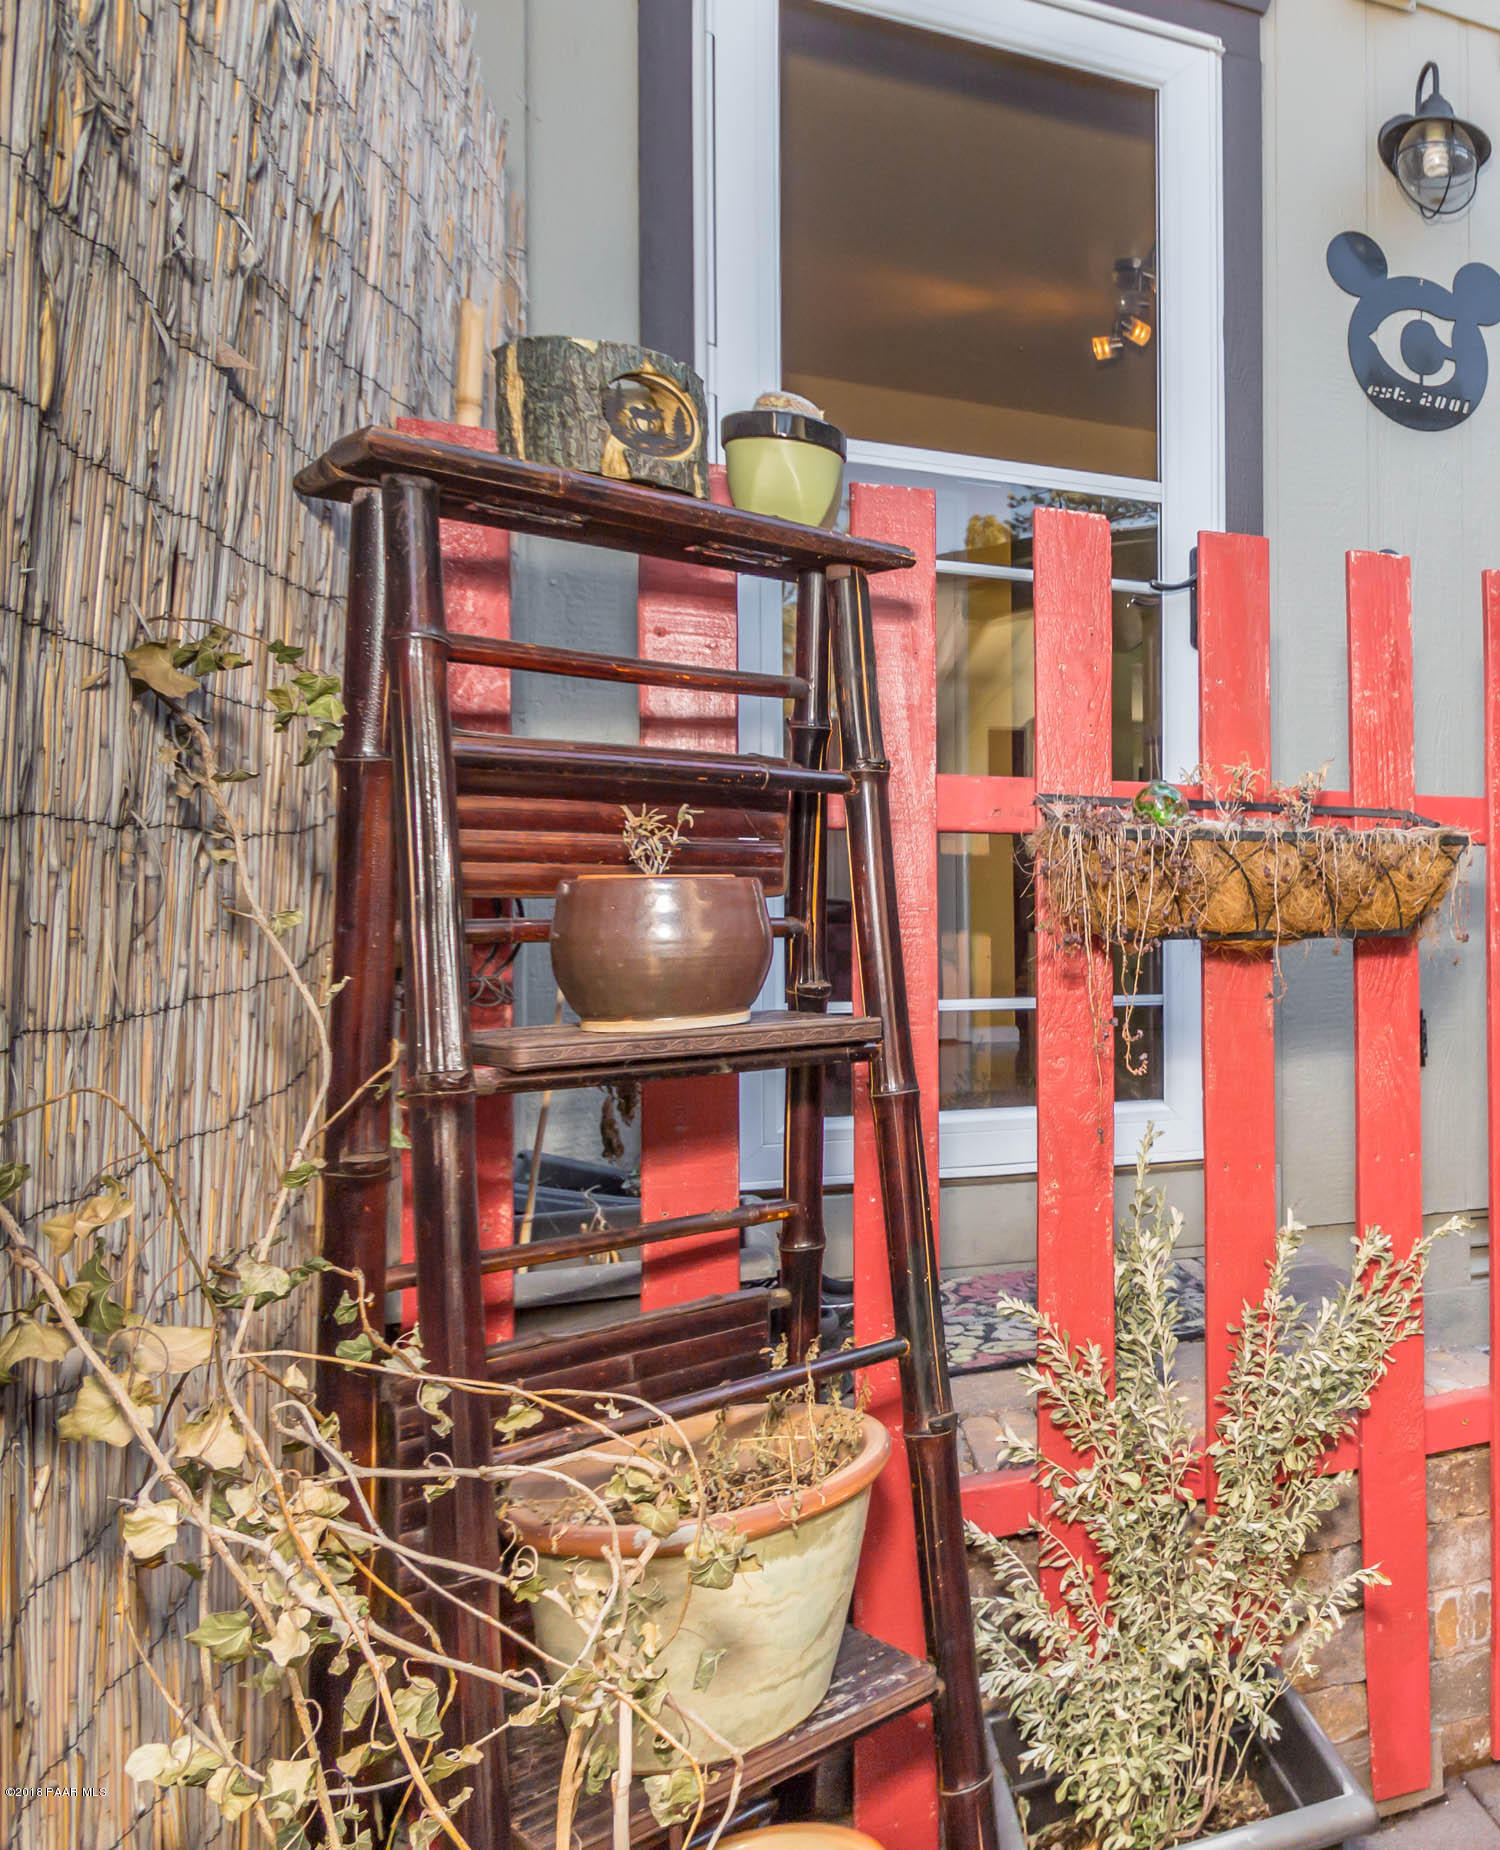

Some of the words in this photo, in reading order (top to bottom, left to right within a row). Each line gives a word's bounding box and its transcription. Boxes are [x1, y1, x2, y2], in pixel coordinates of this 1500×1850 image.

[1368, 309, 1456, 387] C
[1367, 384, 1411, 403] est.
[1419, 392, 1470, 414] 2001
